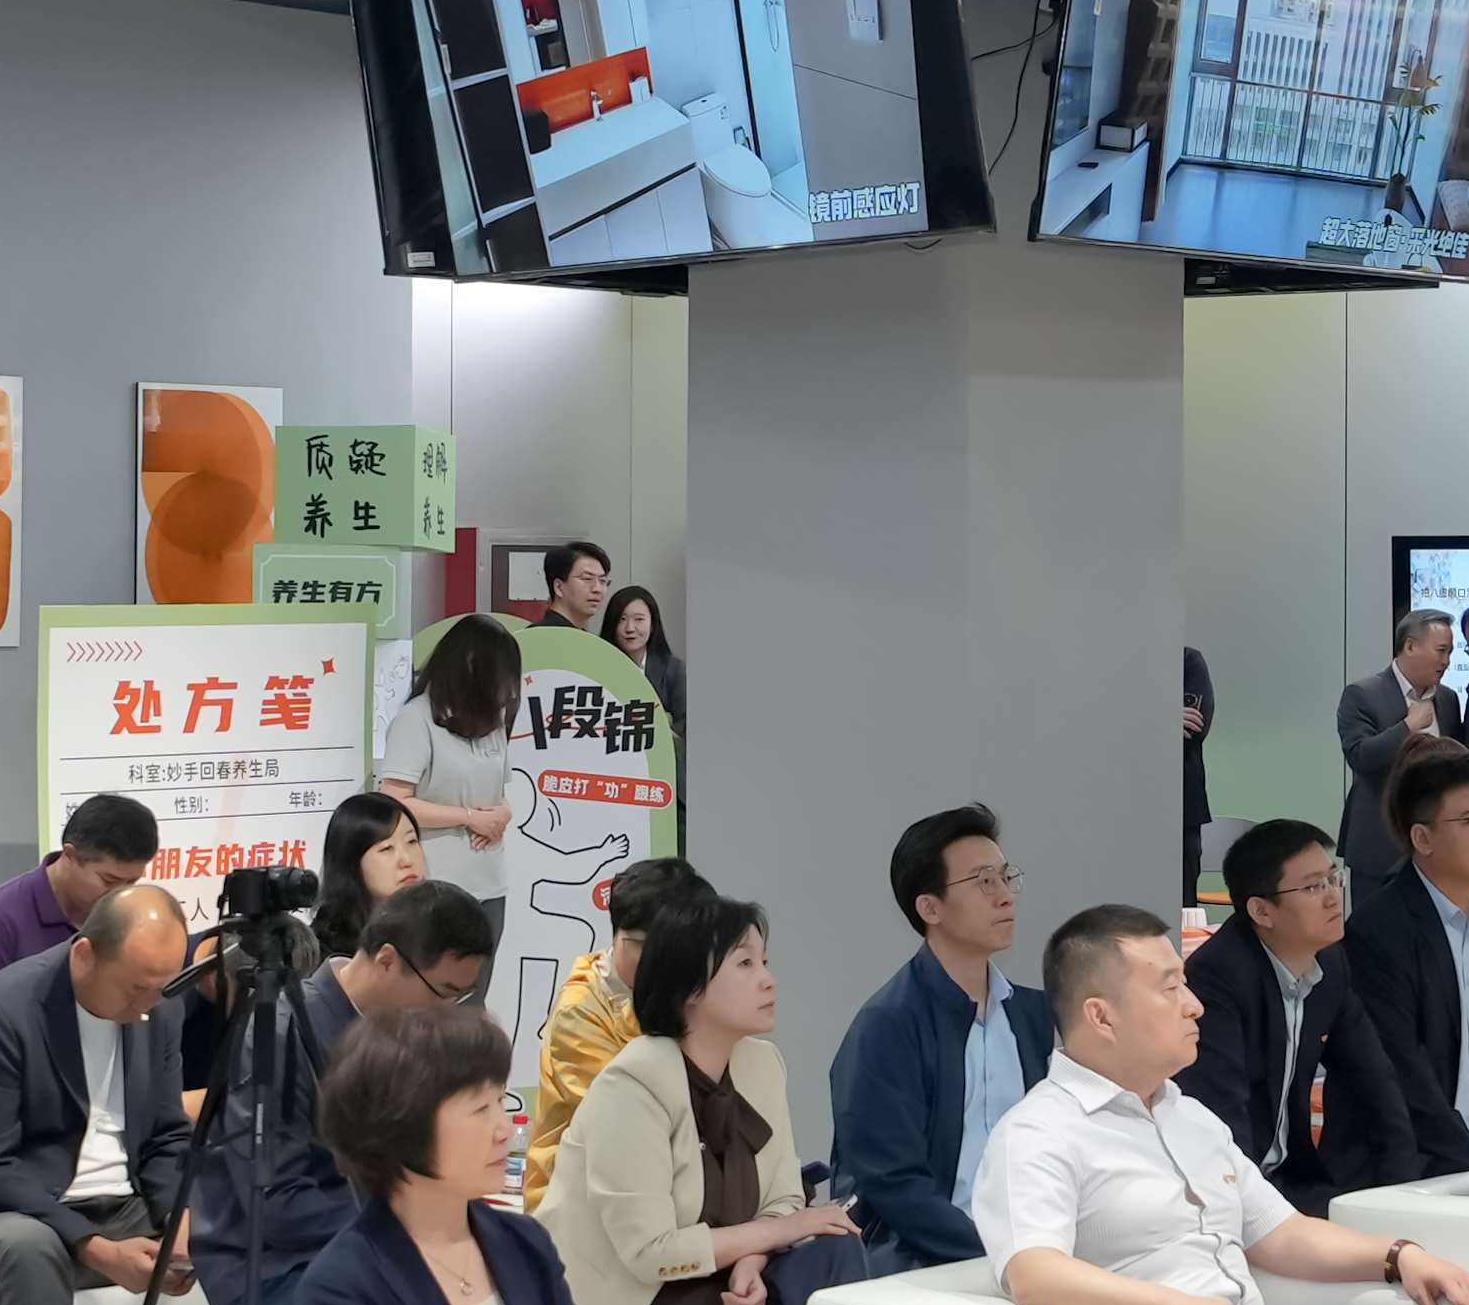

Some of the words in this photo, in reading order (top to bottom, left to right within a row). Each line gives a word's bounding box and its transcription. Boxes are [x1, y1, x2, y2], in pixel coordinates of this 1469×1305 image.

[809, 182, 920, 223] 镜前感应灯
[305, 434, 387, 481] 质疑
[303, 493, 381, 538] 养生
[272, 580, 383, 604] 养生有方
[109, 674, 315, 735] 处方笺
[141, 839, 307, 881] 朋友的症状
